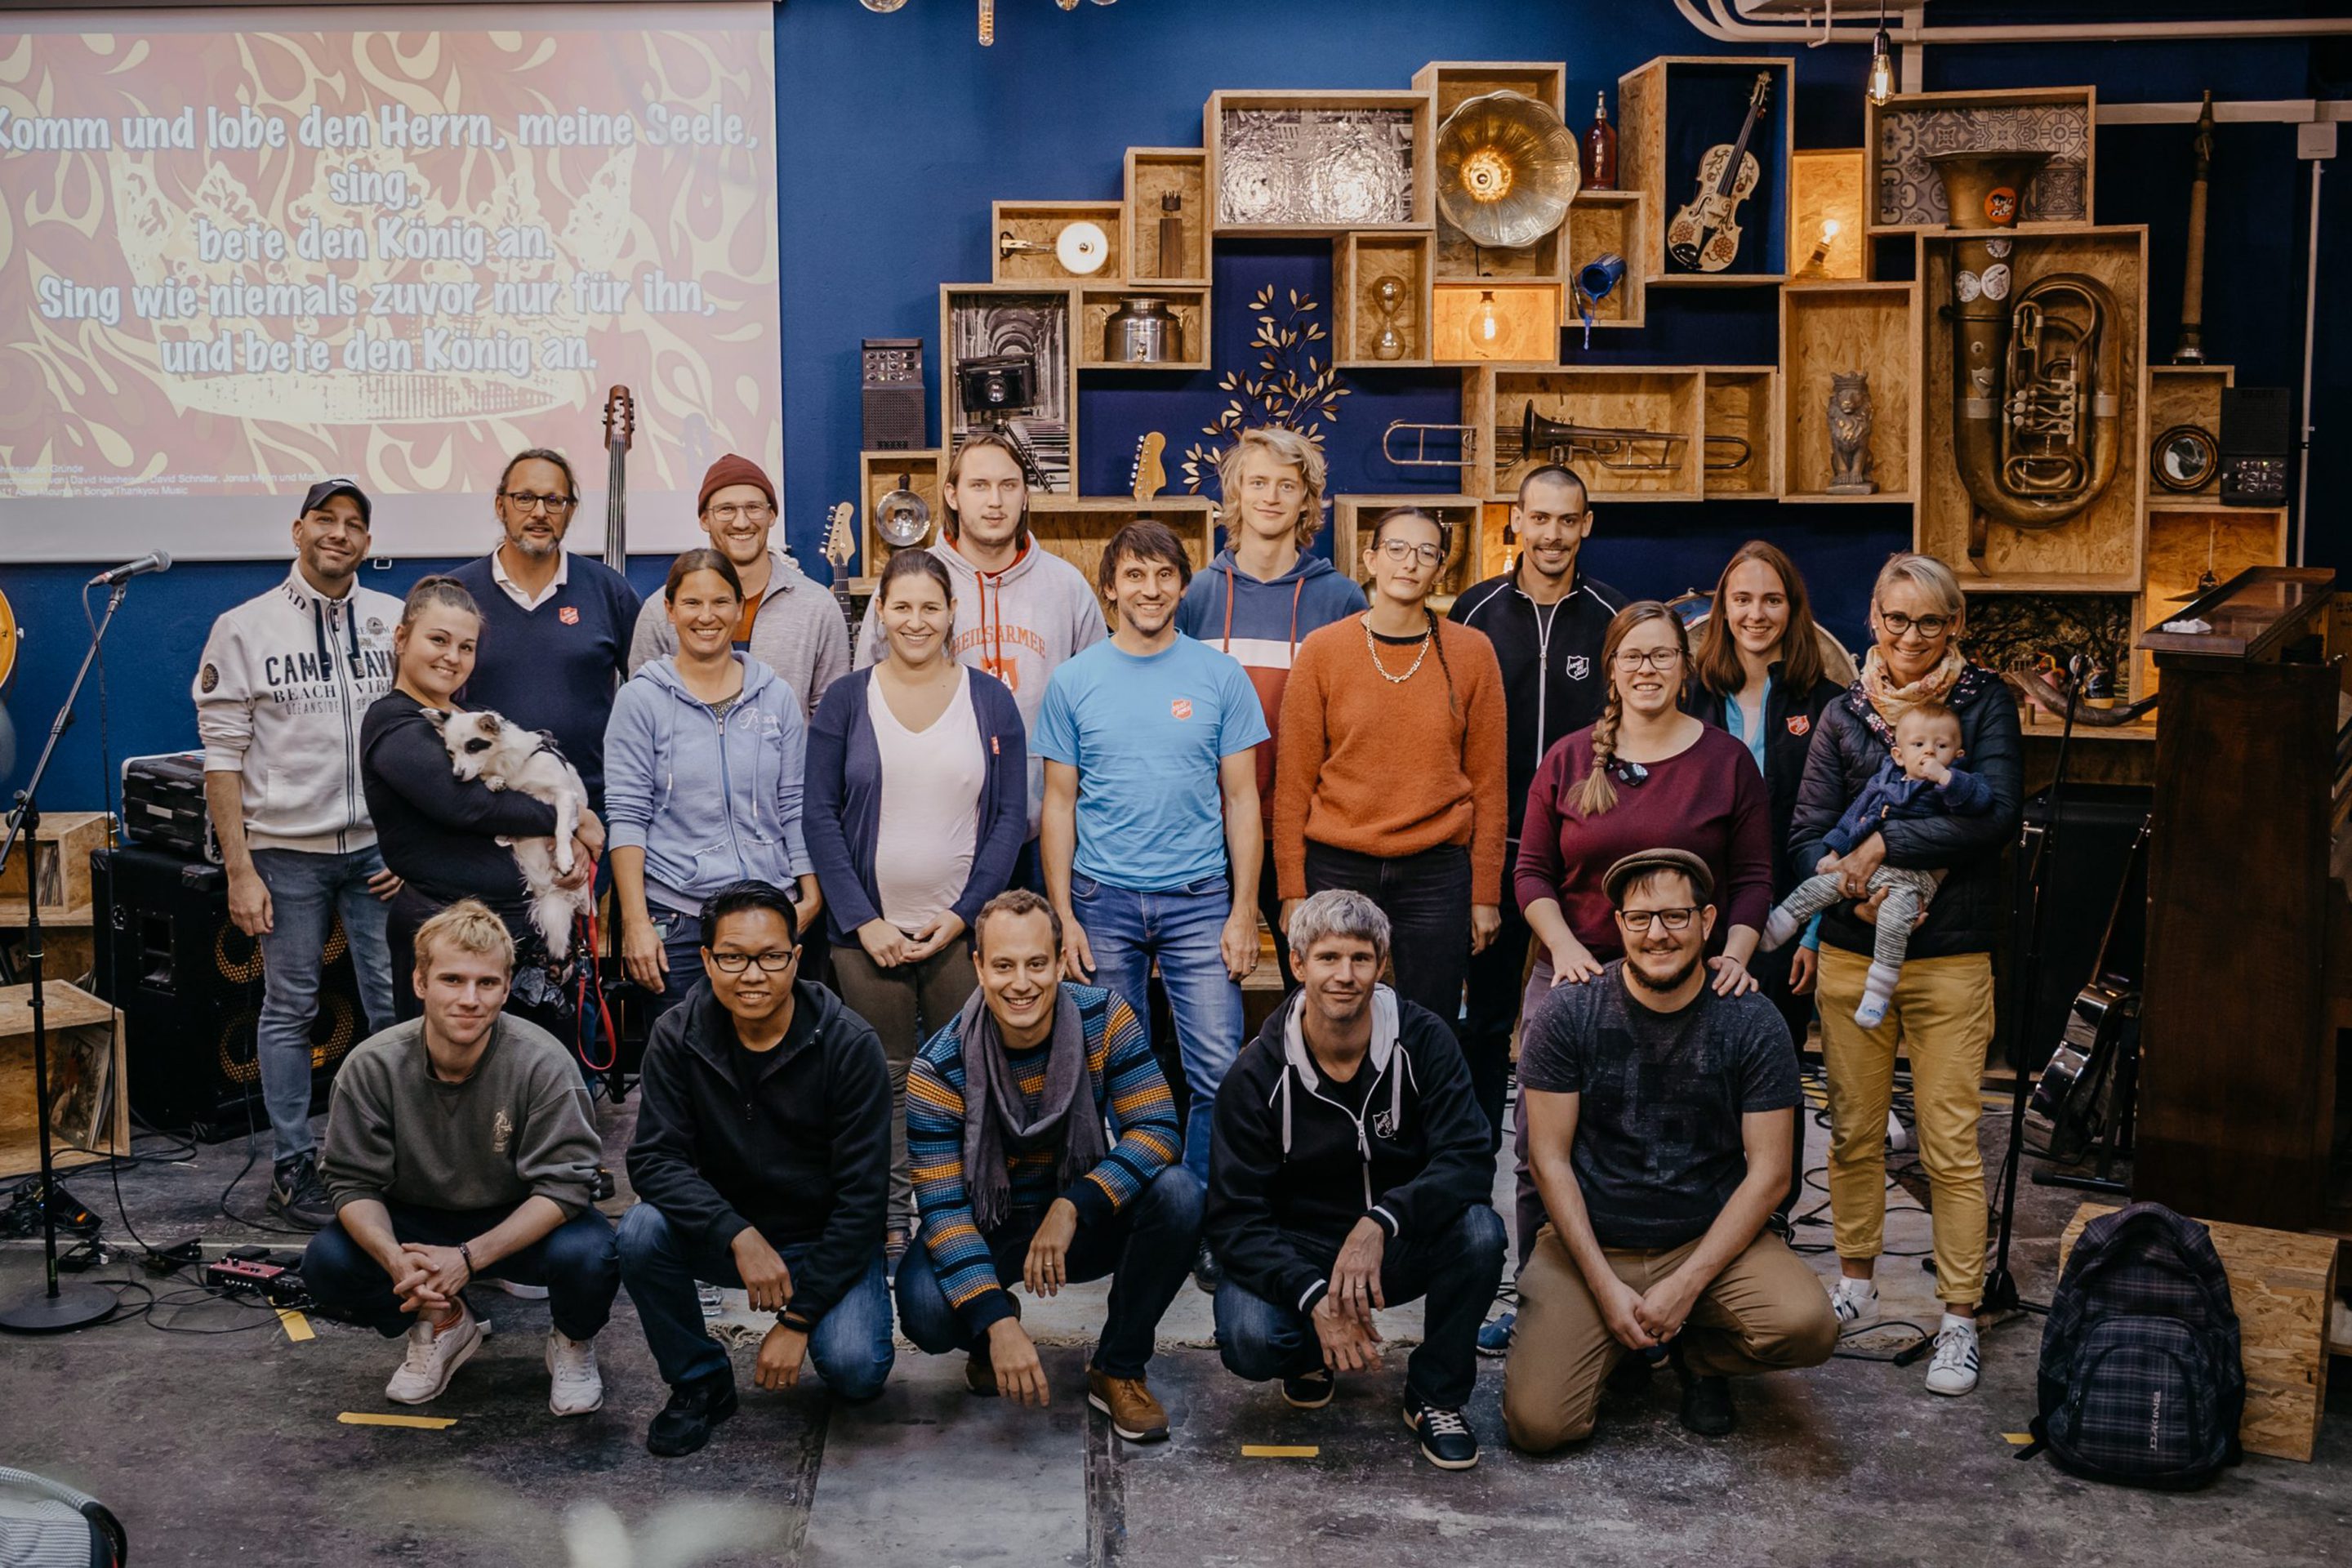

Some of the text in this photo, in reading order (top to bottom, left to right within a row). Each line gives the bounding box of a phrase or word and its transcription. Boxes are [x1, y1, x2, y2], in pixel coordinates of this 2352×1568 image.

[122, 106, 195, 149] und
[207, 105, 287, 149] lobe
[299, 105, 370, 148] den
[380, 104, 506, 150] Herrn,
[518, 107, 633, 146] meine
[646, 102, 759, 149] Seele,
[329, 163, 421, 211] sing,
[198, 215, 556, 265] bete den König an.
[38, 270, 716, 325] Sing wie niemals zuvor nur für ihn,
[162, 327, 598, 377] und bete den König an.
[70, 475, 96, 484] David
[150, 474, 176, 483] David
[279, 473, 296, 482] und
[161, 485, 189, 495] Music
[273, 684, 336, 703] BEACH
